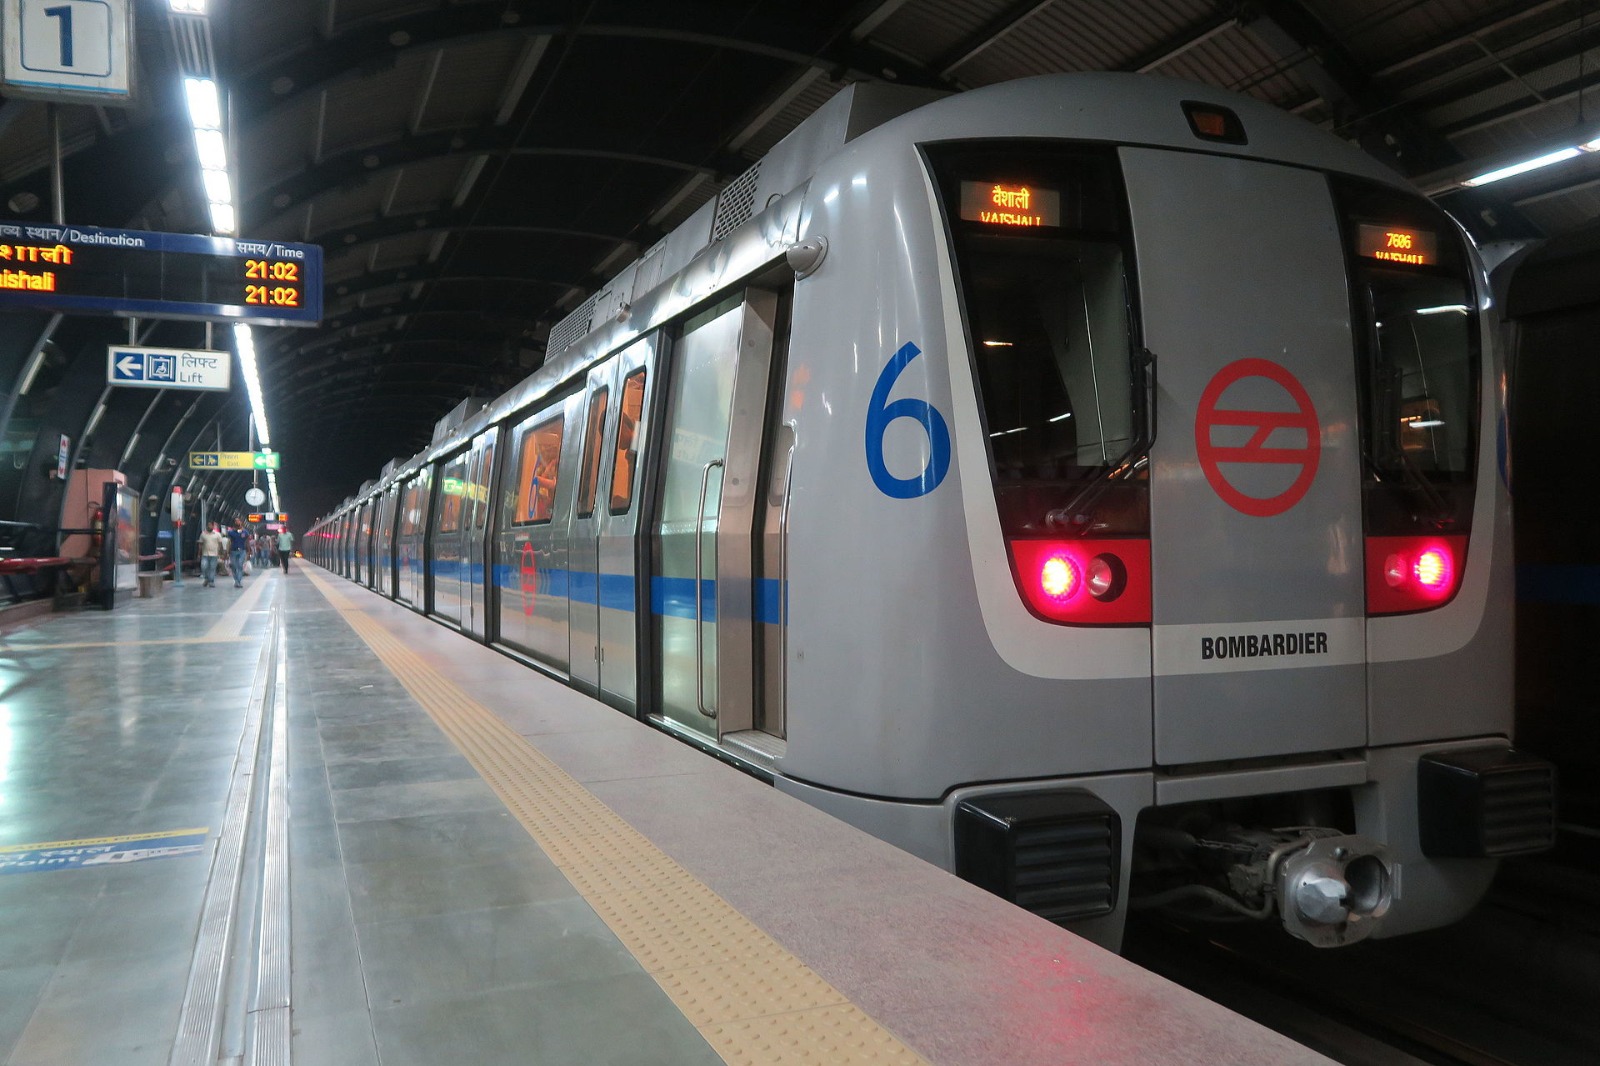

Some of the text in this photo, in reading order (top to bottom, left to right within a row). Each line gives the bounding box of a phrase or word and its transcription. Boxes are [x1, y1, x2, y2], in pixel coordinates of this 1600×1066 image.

[44, 5, 73, 67] 1
[992, 185, 1030, 209] वैशाली
[0, 268, 55, 291] ishali
[245, 260, 298, 282] 21:02
[245, 285, 298, 306] 21:02
[181, 352, 218, 369] लिफ्ट
[180, 372, 203, 383] Lift
[865, 340, 951, 499] 6
[1201, 632, 1328, 660] BOMBARDIER
